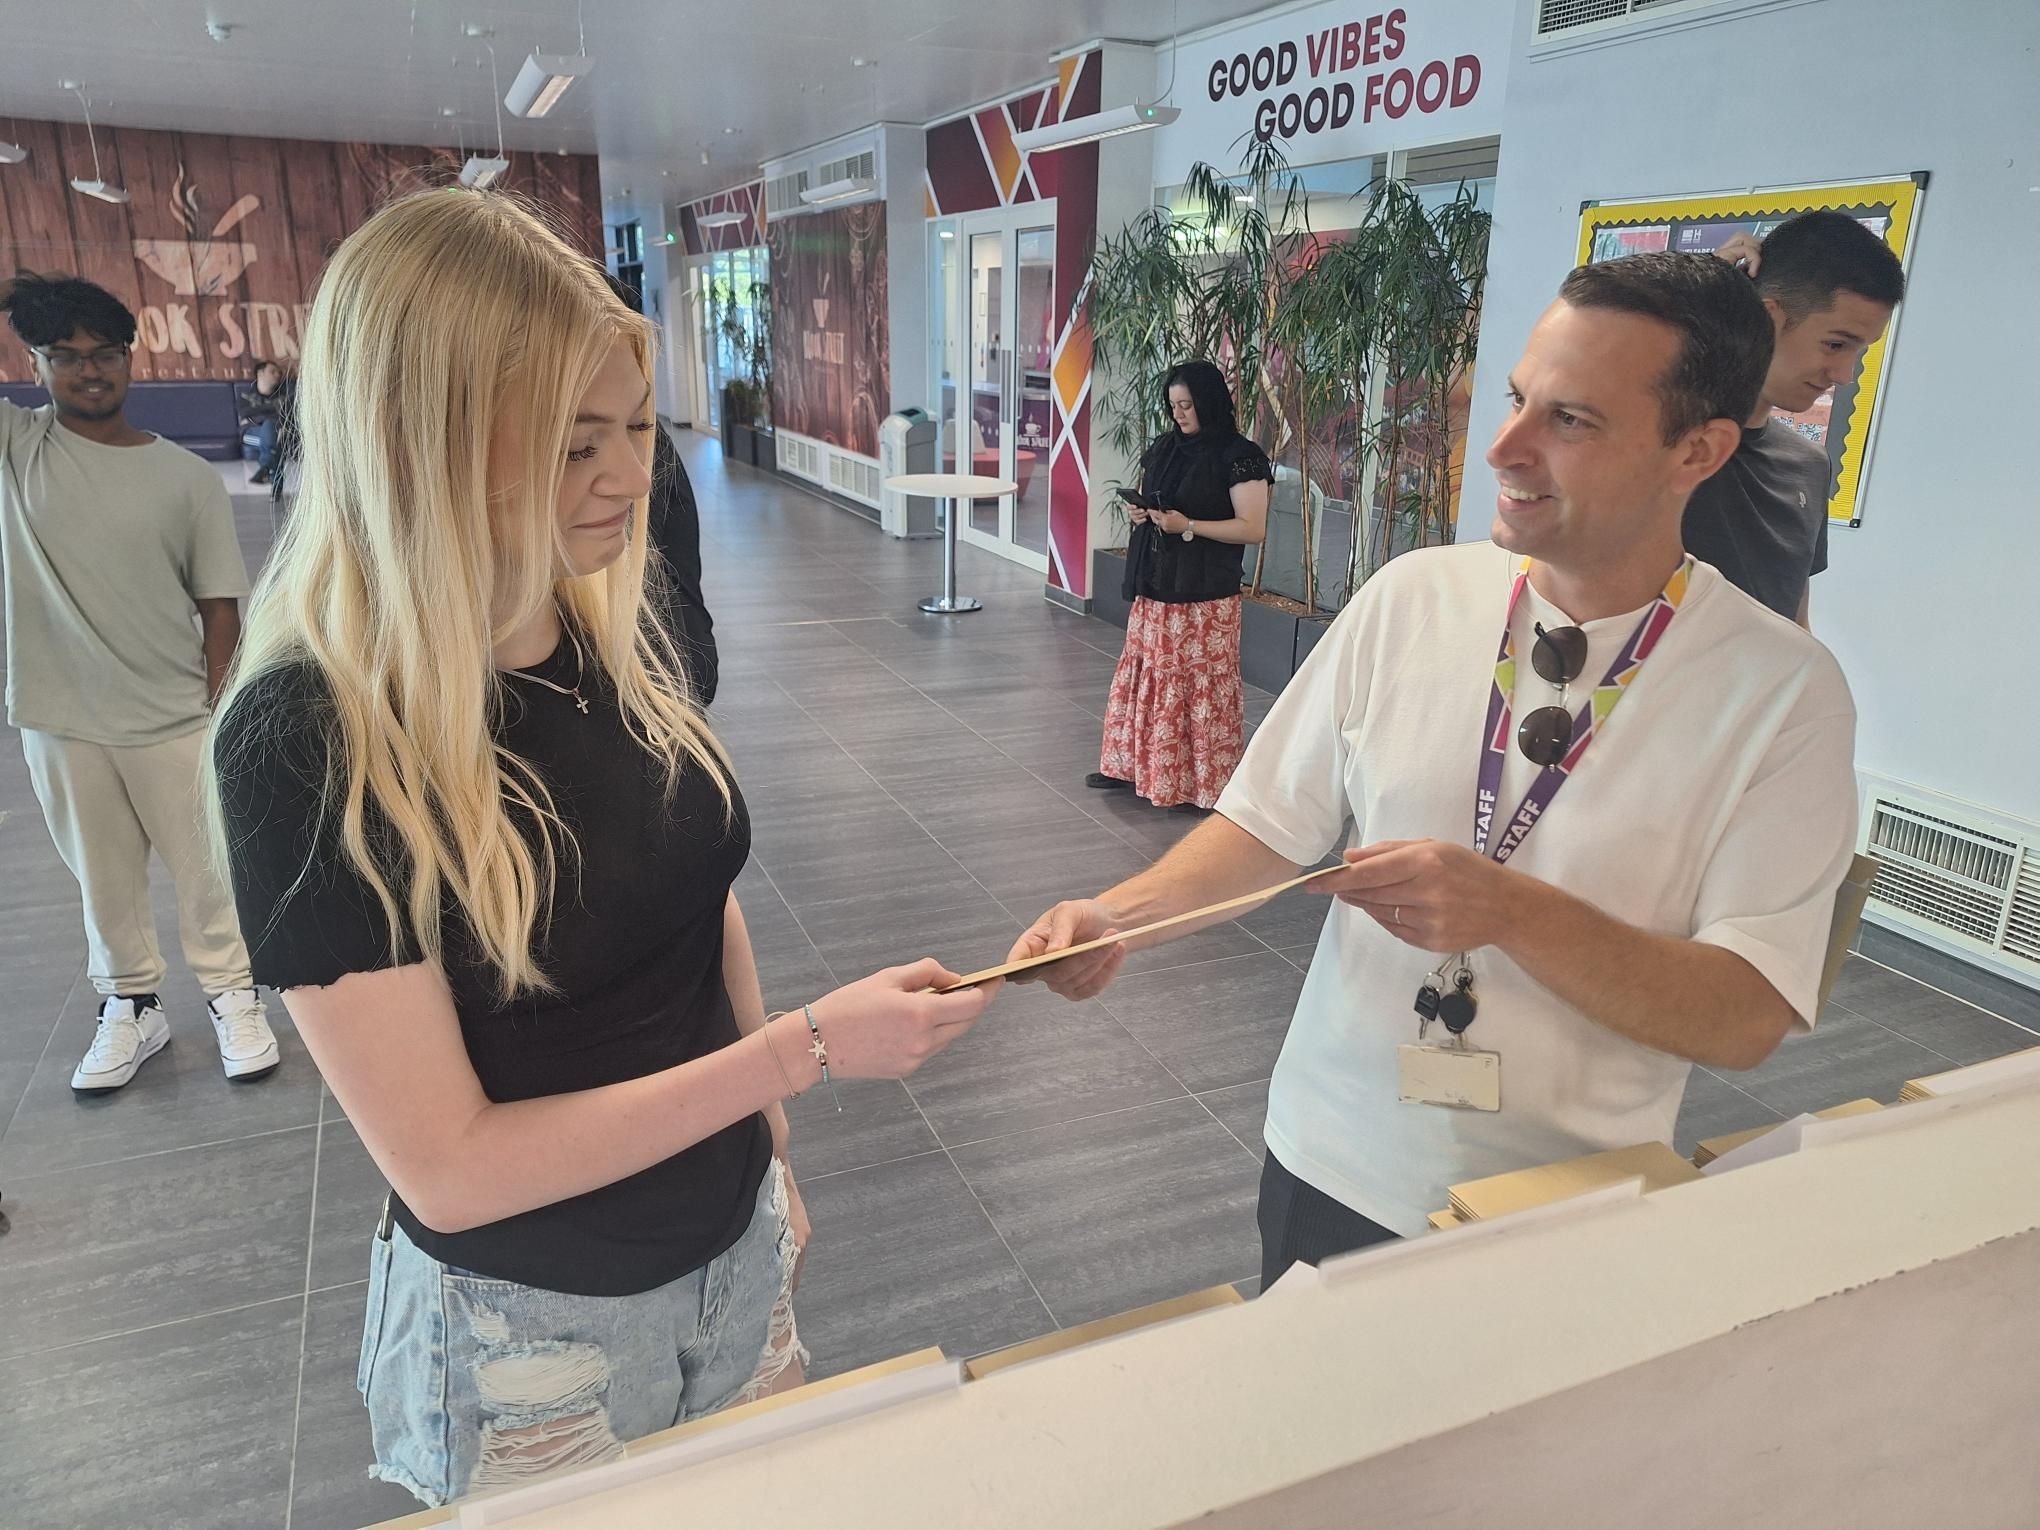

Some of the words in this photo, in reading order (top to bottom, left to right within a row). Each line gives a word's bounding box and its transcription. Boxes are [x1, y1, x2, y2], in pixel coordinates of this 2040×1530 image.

[1208, 41, 1298, 102] GOOD
[1306, 8, 1407, 78] VIBES
[1254, 82, 1355, 142] GOOD
[1363, 54, 1481, 124] FOOD
[130, 303, 203, 358] OK
[1475, 789, 1495, 855] STAFF
[1497, 799, 1541, 860] STAFF
